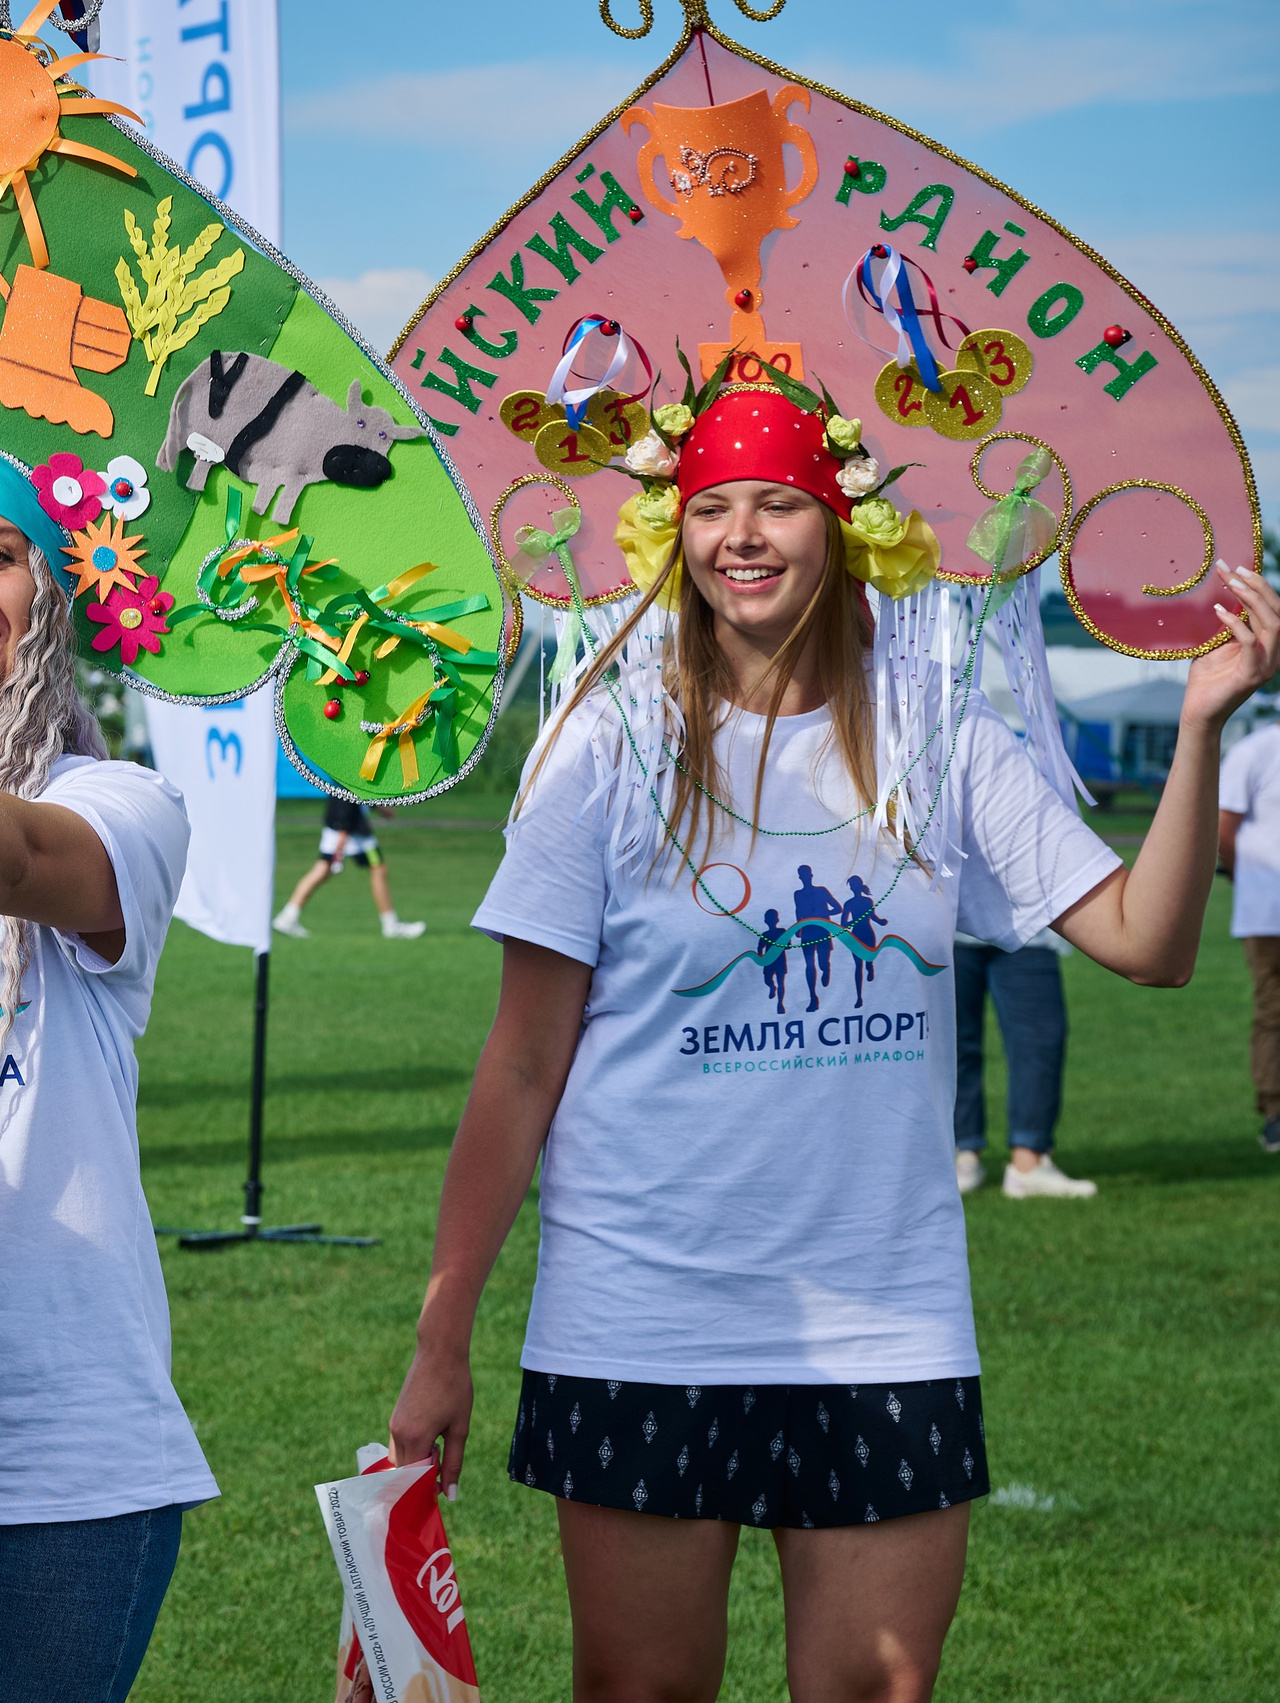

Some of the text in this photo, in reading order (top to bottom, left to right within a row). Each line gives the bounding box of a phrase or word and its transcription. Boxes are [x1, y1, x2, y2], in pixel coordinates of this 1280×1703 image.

[410, 154, 1159, 437] ЙСКИЙ РАЙОН
[984, 340, 1016, 386] 3
[511, 398, 540, 432] 2
[894, 374, 922, 417] 2
[949, 384, 984, 426] 1
[604, 399, 632, 446] 3
[557, 432, 591, 463] 1
[679, 1010, 929, 1055] ЗЕМЛЯ СПОРТ
[703, 1050, 925, 1074] ВСЕРОССИЙСКИЙ МАРАФОН
[333, 1512, 348, 1539] ТОВАР
[340, 1540, 364, 1590] АЛТАЙСКИЙ
[368, 1633, 378, 1641] И
[378, 1664, 396, 1700] РОССИИ
